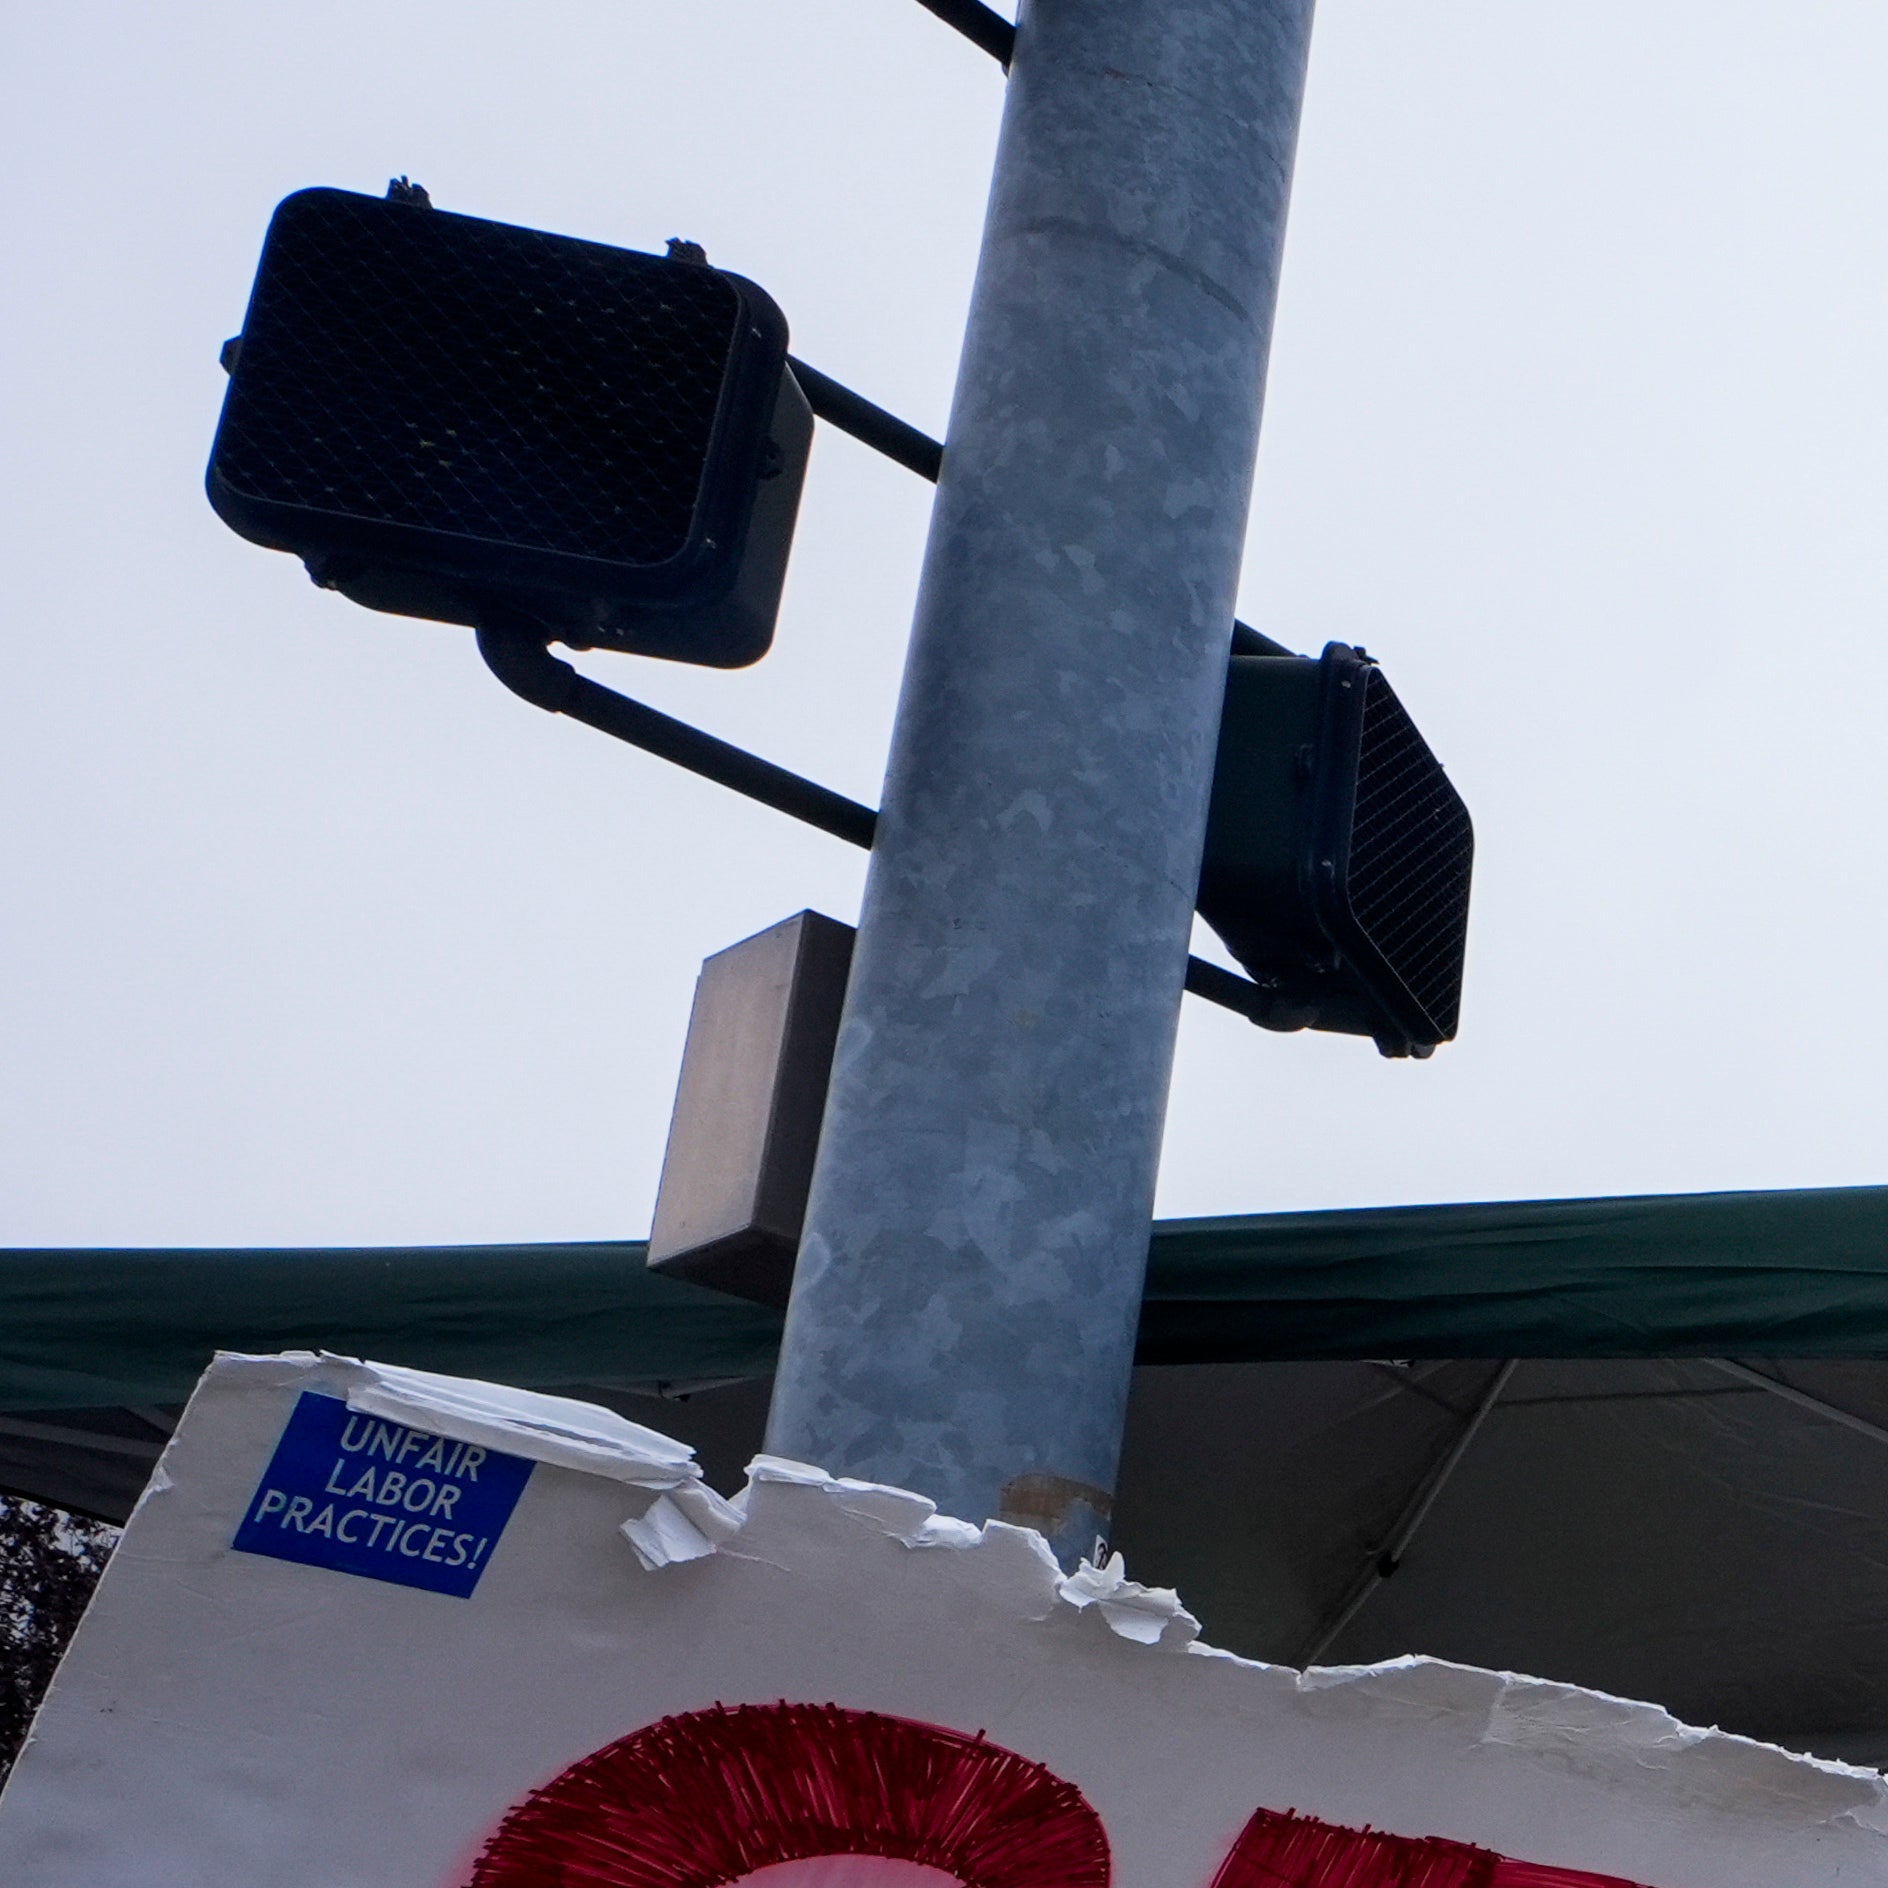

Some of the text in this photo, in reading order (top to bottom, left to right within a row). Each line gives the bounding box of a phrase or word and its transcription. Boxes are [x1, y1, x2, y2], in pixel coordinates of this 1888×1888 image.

[340, 1416, 487, 1483] UNFAIR
[325, 1459, 463, 1519] LABOR
[254, 1490, 487, 1570] PRACTICES!
